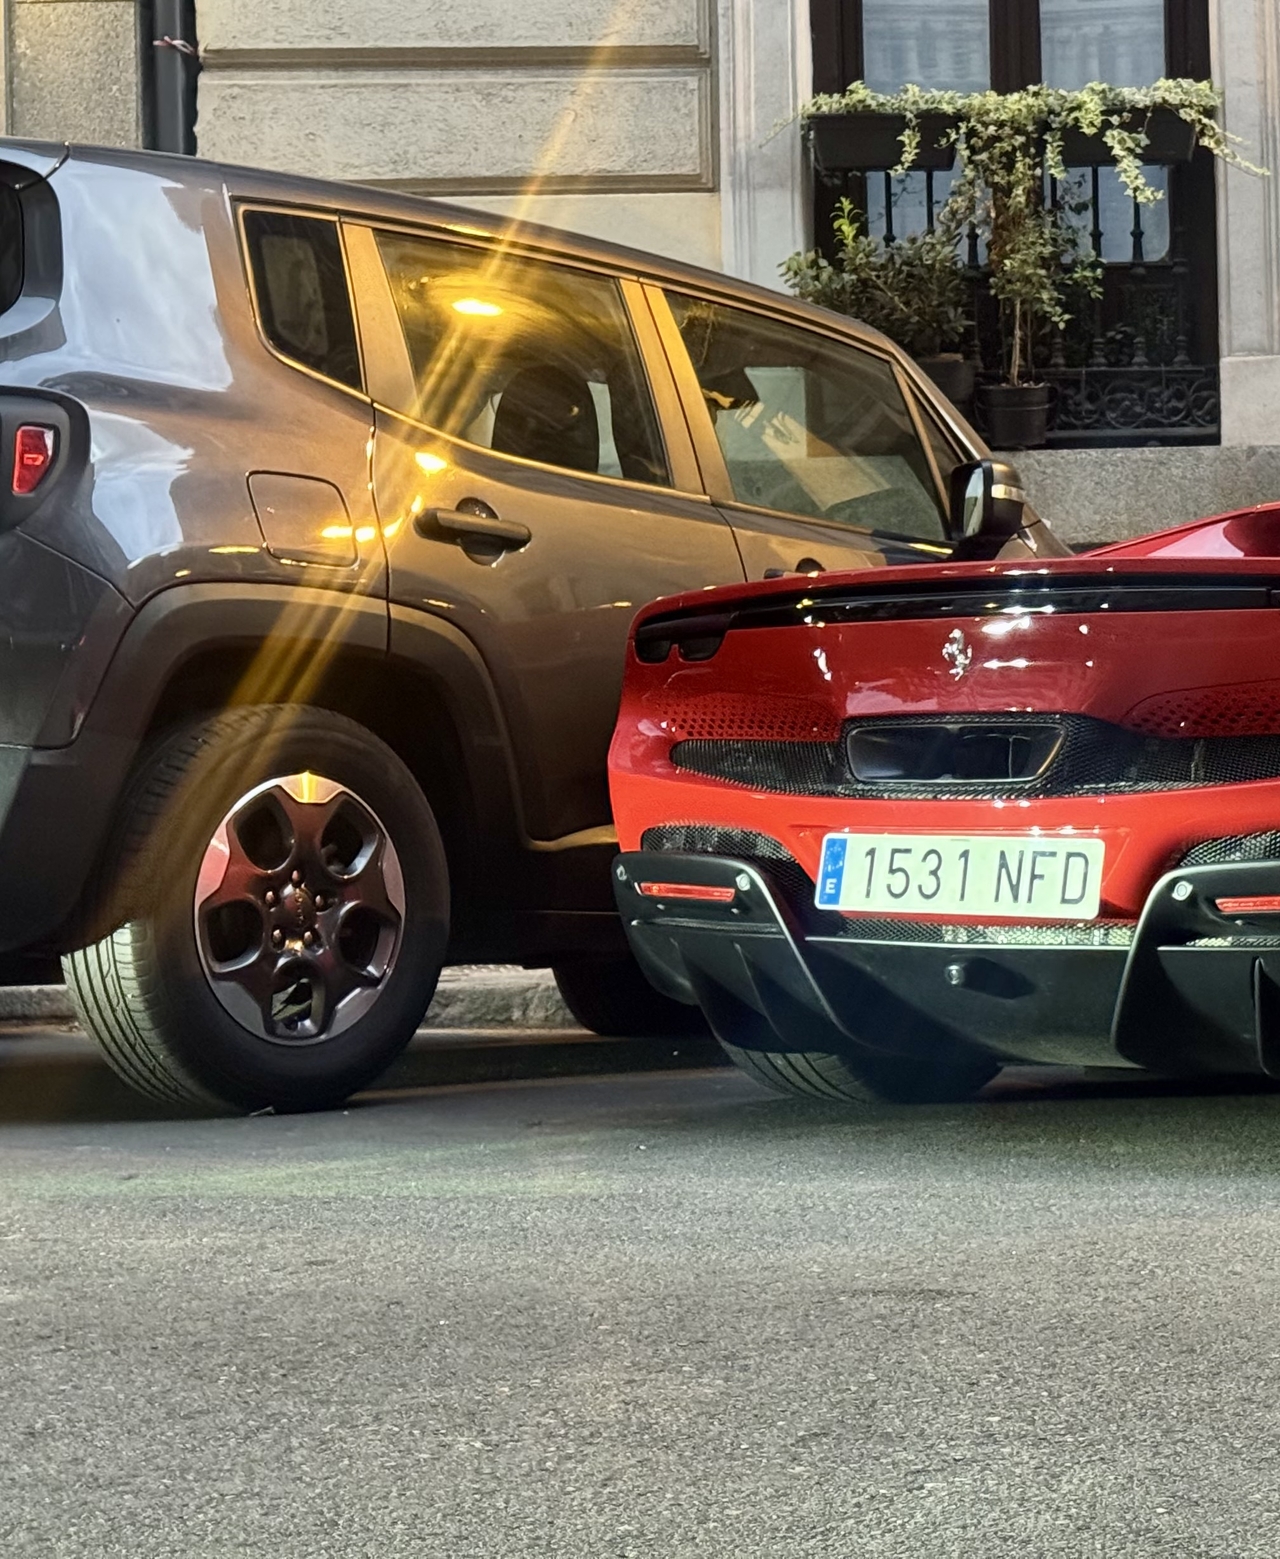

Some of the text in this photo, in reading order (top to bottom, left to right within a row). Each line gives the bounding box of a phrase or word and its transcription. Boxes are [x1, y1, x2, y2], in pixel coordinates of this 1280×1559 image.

[825, 878, 838, 895] E
[864, 846, 1089, 905] 1531 NFD
